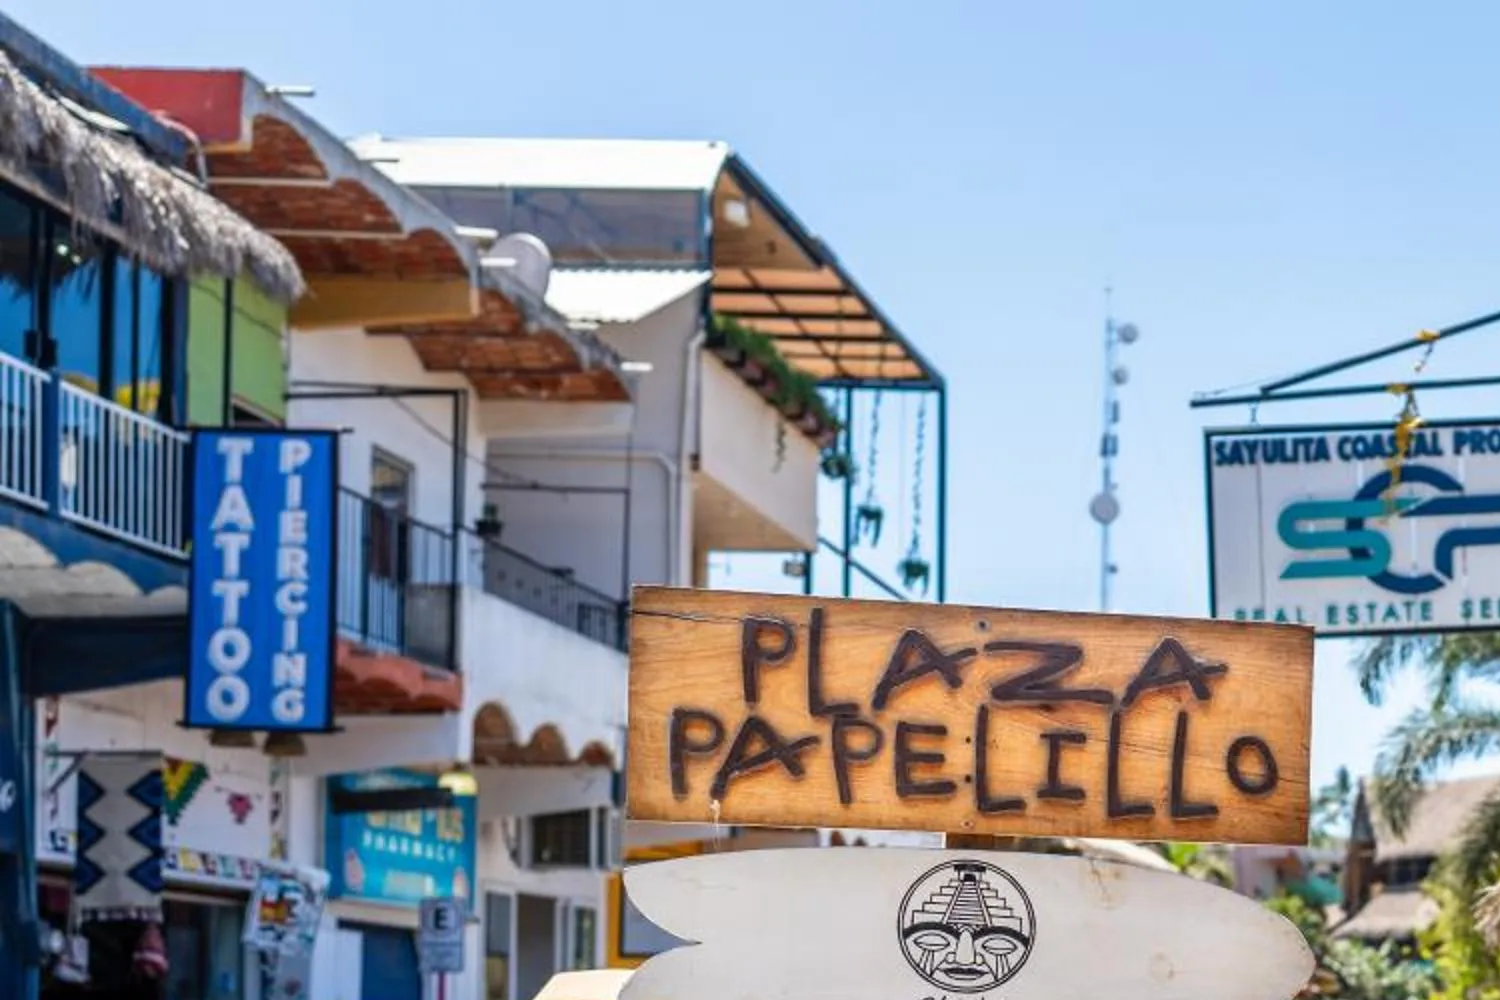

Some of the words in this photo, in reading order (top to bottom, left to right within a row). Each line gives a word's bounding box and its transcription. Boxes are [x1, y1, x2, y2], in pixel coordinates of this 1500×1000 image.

[1214, 438, 1329, 466] SAYULITA
[1339, 430, 1443, 461] COASAL
[207, 437, 256, 722] TATTOO
[271, 438, 312, 724] PIERCING
[1326, 600, 1435, 627] ESTATE
[742, 608, 1228, 717] PLAZA
[669, 704, 1279, 819] PAPELILLO
